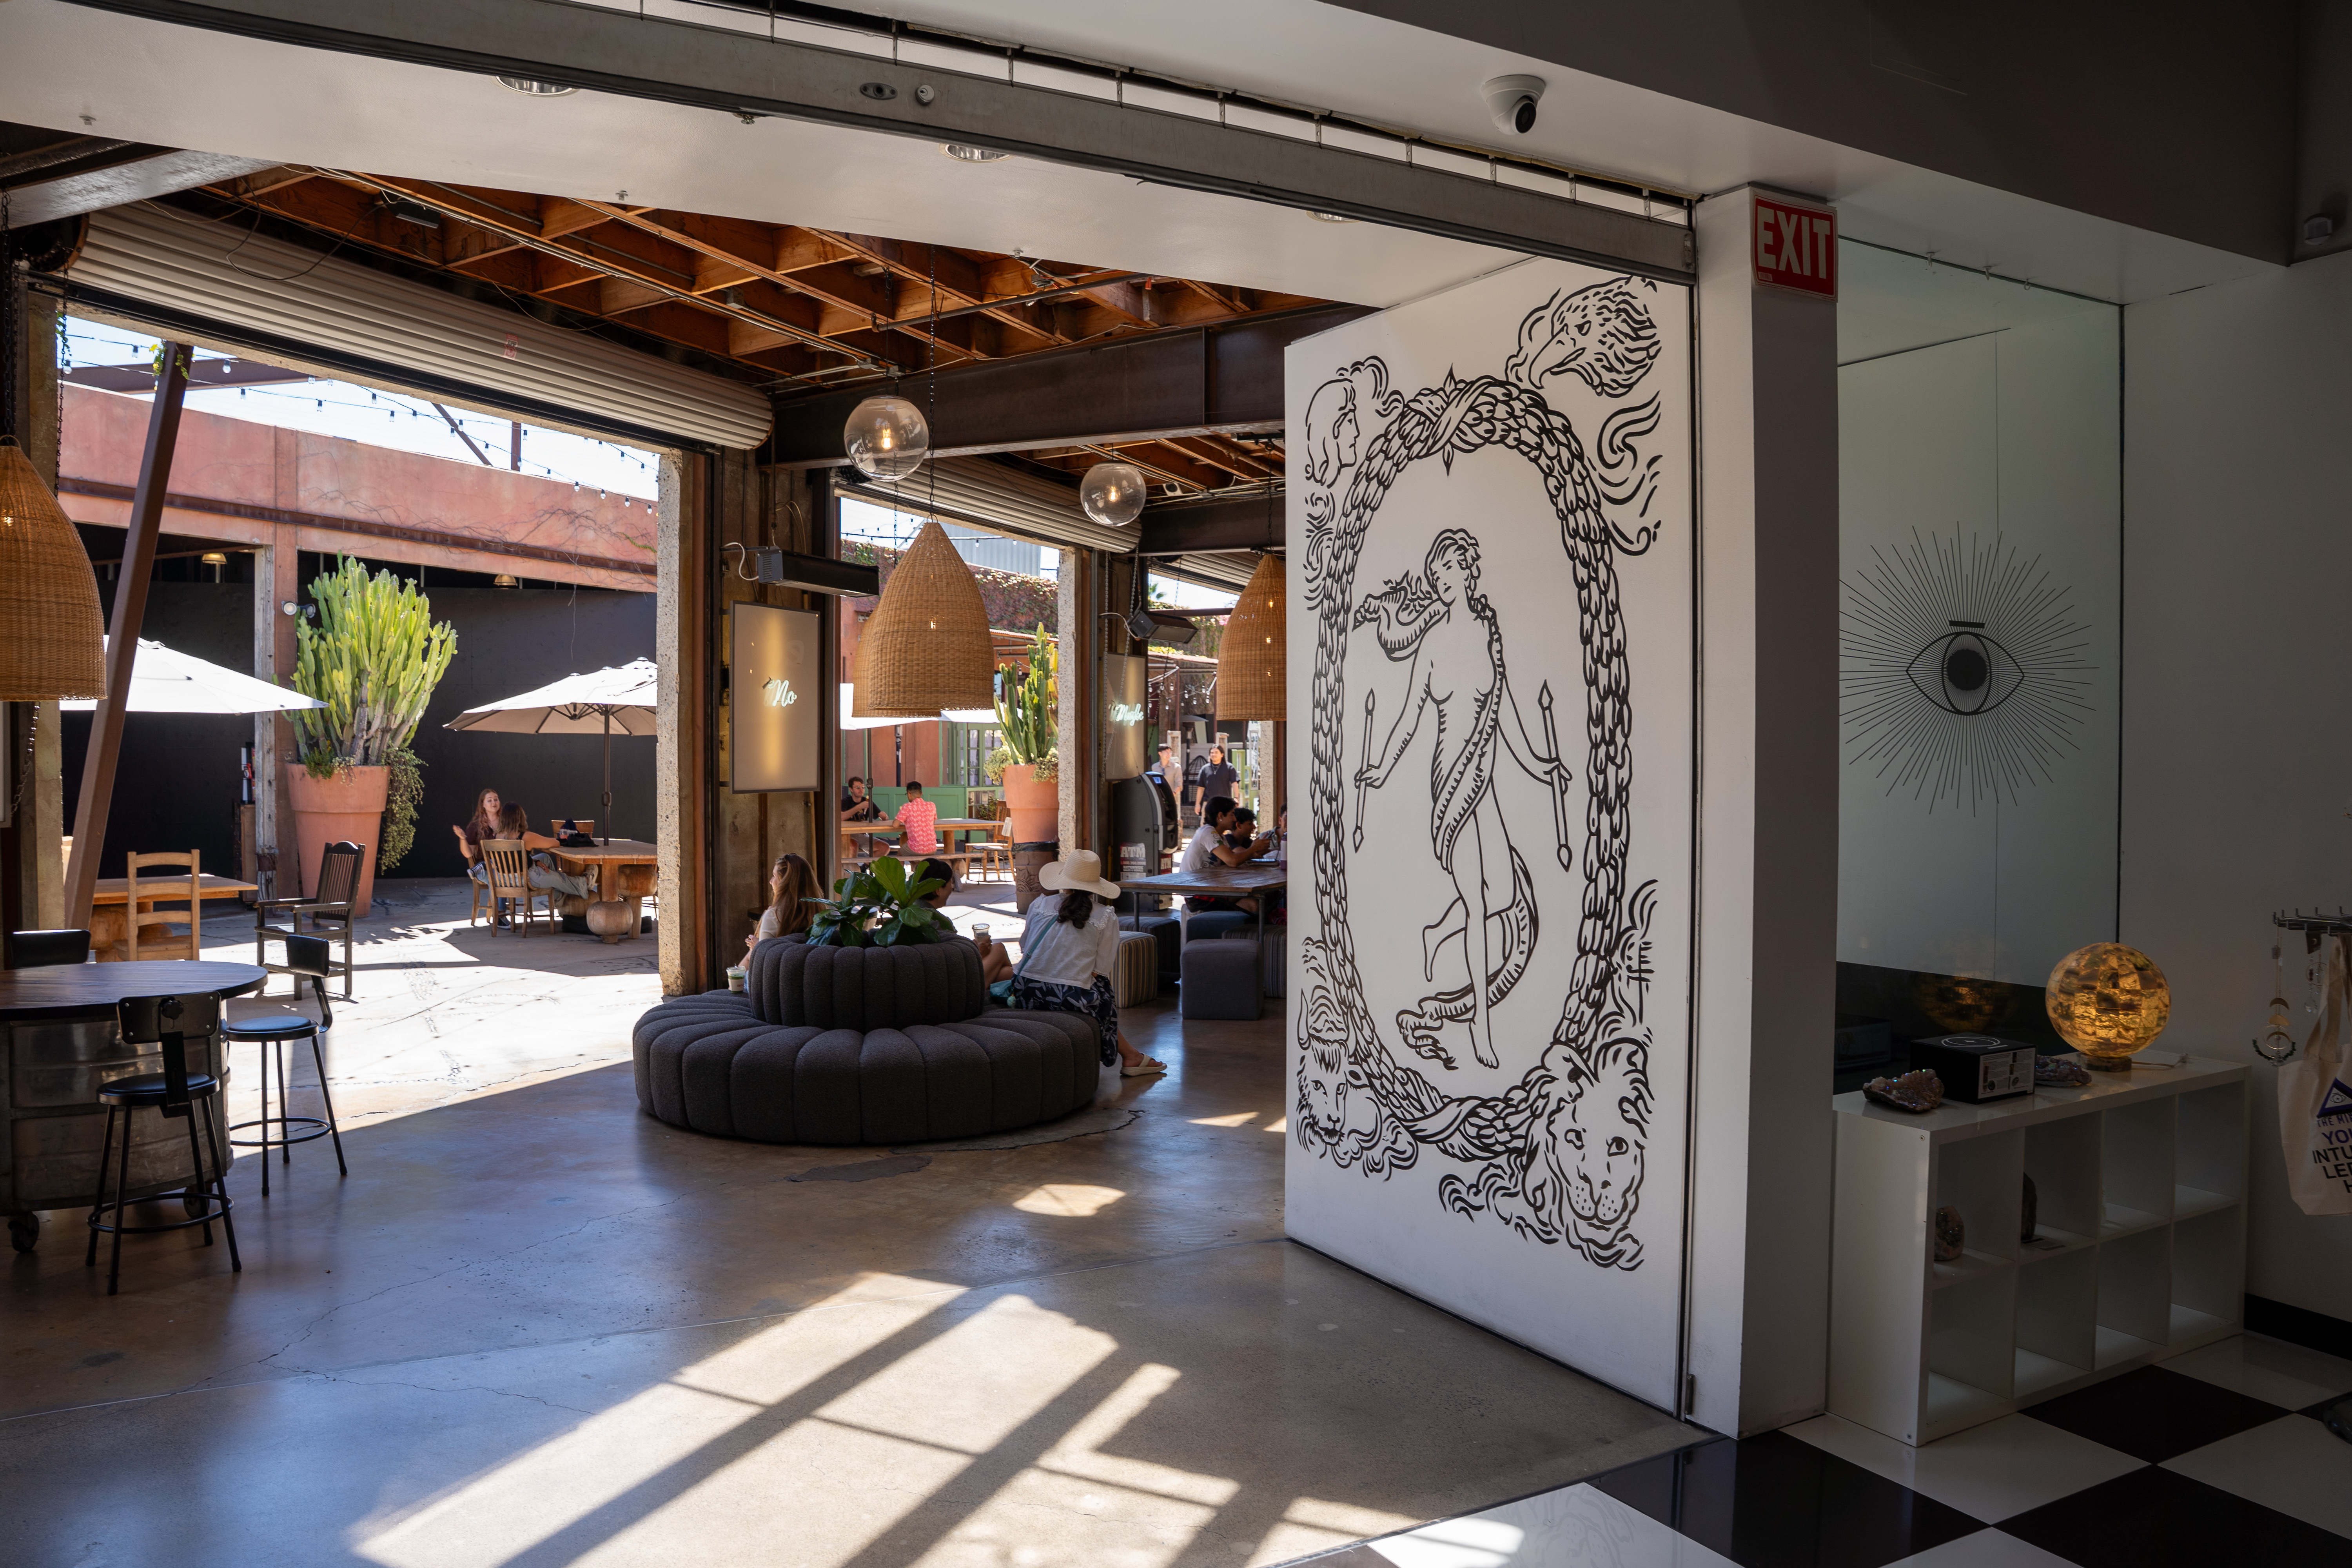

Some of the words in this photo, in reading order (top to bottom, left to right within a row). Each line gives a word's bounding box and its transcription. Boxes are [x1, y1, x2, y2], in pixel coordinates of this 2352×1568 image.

[1757, 205, 1831, 279] EXIT
[768, 679, 797, 707] No
[1115, 703, 1144, 726] Maybe
[1120, 846, 1145, 858] ATM
[1161, 858, 1171, 869] ATM
[2316, 1117, 2334, 1127] THE
[2312, 1145, 2352, 1163] INTU
